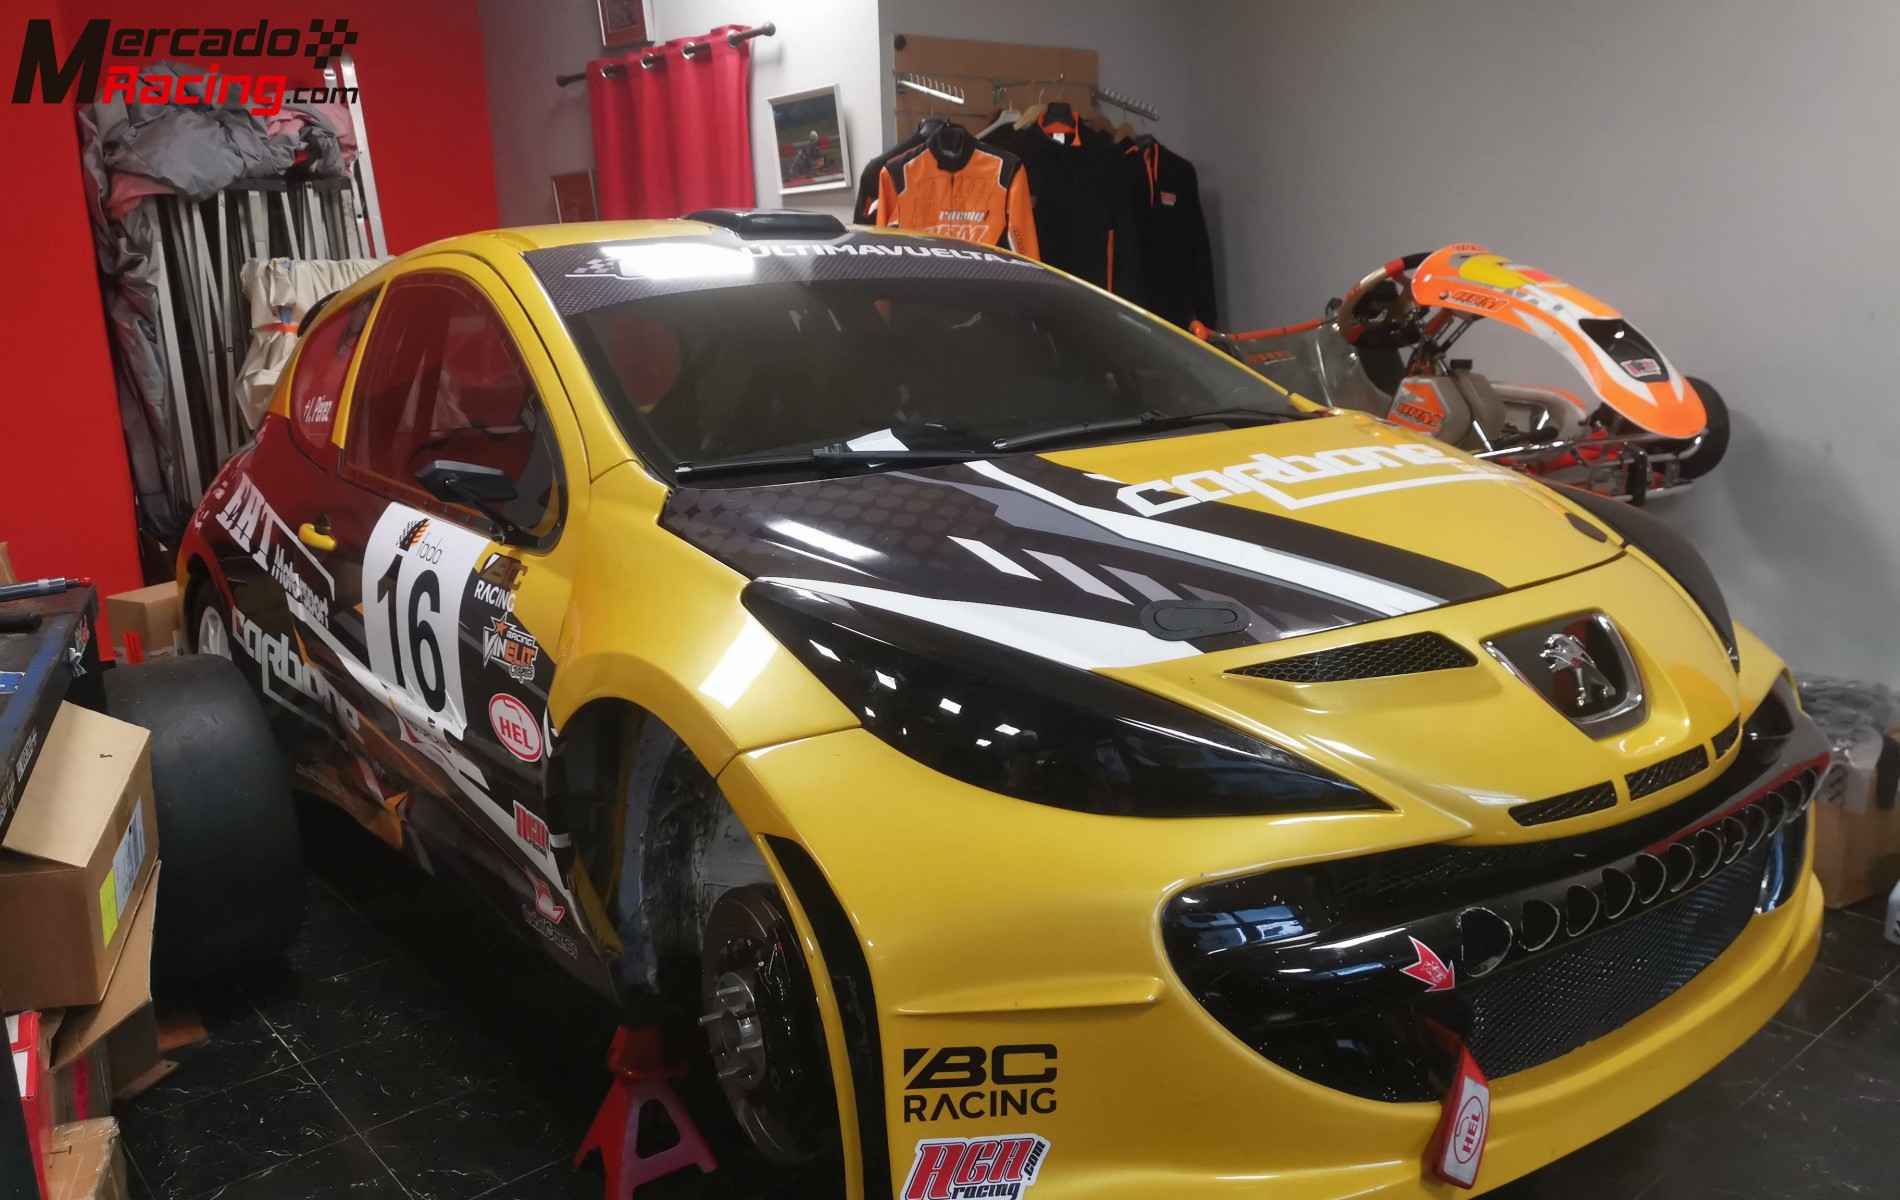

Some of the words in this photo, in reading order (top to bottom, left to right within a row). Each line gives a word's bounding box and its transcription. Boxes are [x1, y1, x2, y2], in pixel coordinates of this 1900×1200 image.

[417, 532, 443, 565] fada
[377, 553, 446, 713] 16
[499, 716, 533, 752] HEL
[904, 1088, 1057, 1123] RACING
[1462, 1110, 1481, 1154] HEL
[952, 1183, 1021, 1200] racing
